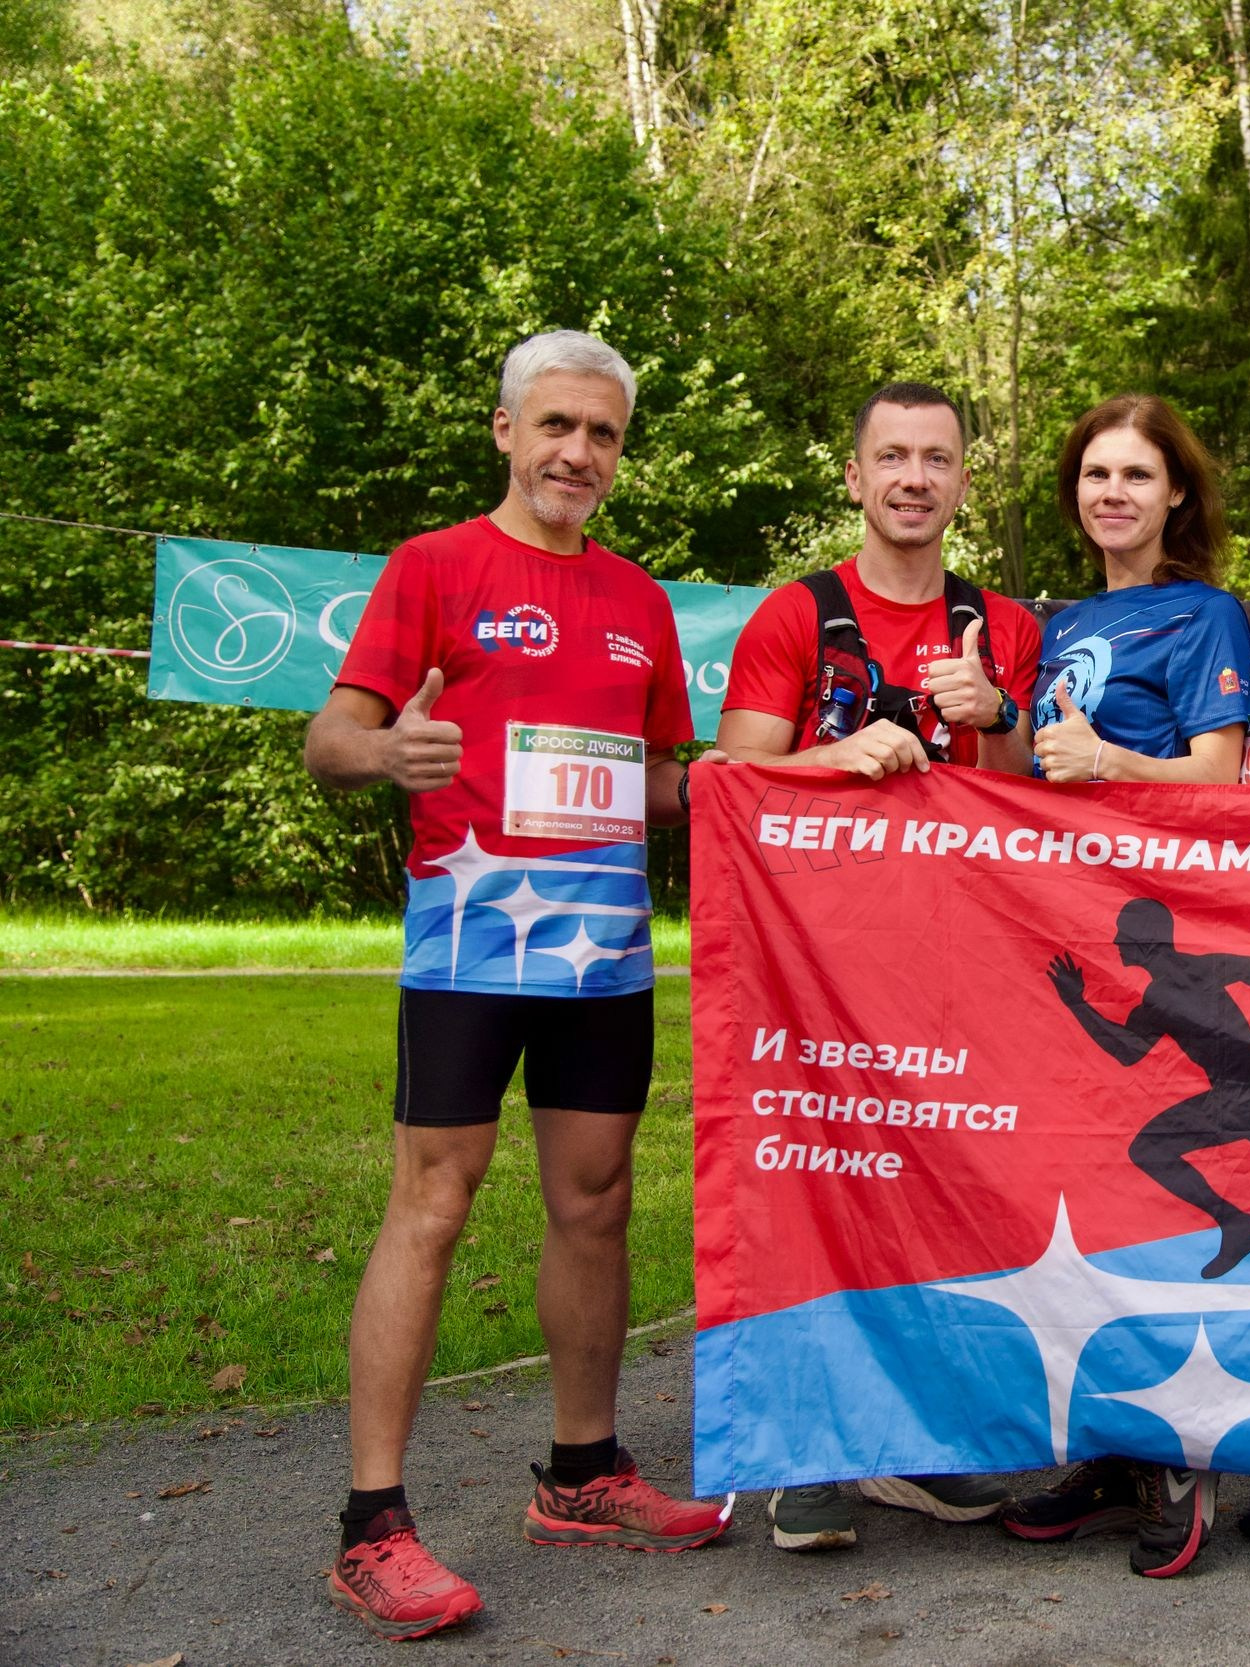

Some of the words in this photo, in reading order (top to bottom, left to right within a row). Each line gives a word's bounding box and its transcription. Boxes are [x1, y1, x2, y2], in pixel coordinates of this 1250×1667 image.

[477, 621, 548, 640] БЕГИ
[508, 603, 560, 658] КРАСНОЗНАМЕНСК
[606, 632, 614, 641] И
[610, 653, 642, 667] БЛИЖЕ
[916, 644, 928, 656] И
[526, 735, 584, 751] КРОСС
[587, 740, 633, 756] ДУБКИ
[550, 763, 613, 810] 170
[523, 819, 583, 830] Апрелевка
[592, 823, 634, 835] 14.09.25
[759, 813, 888, 851] БЕГИ
[751, 1027, 787, 1061] И
[798, 1039, 968, 1078] звезды
[752, 1088, 1018, 1131] становятся
[755, 1134, 903, 1178] ближе
